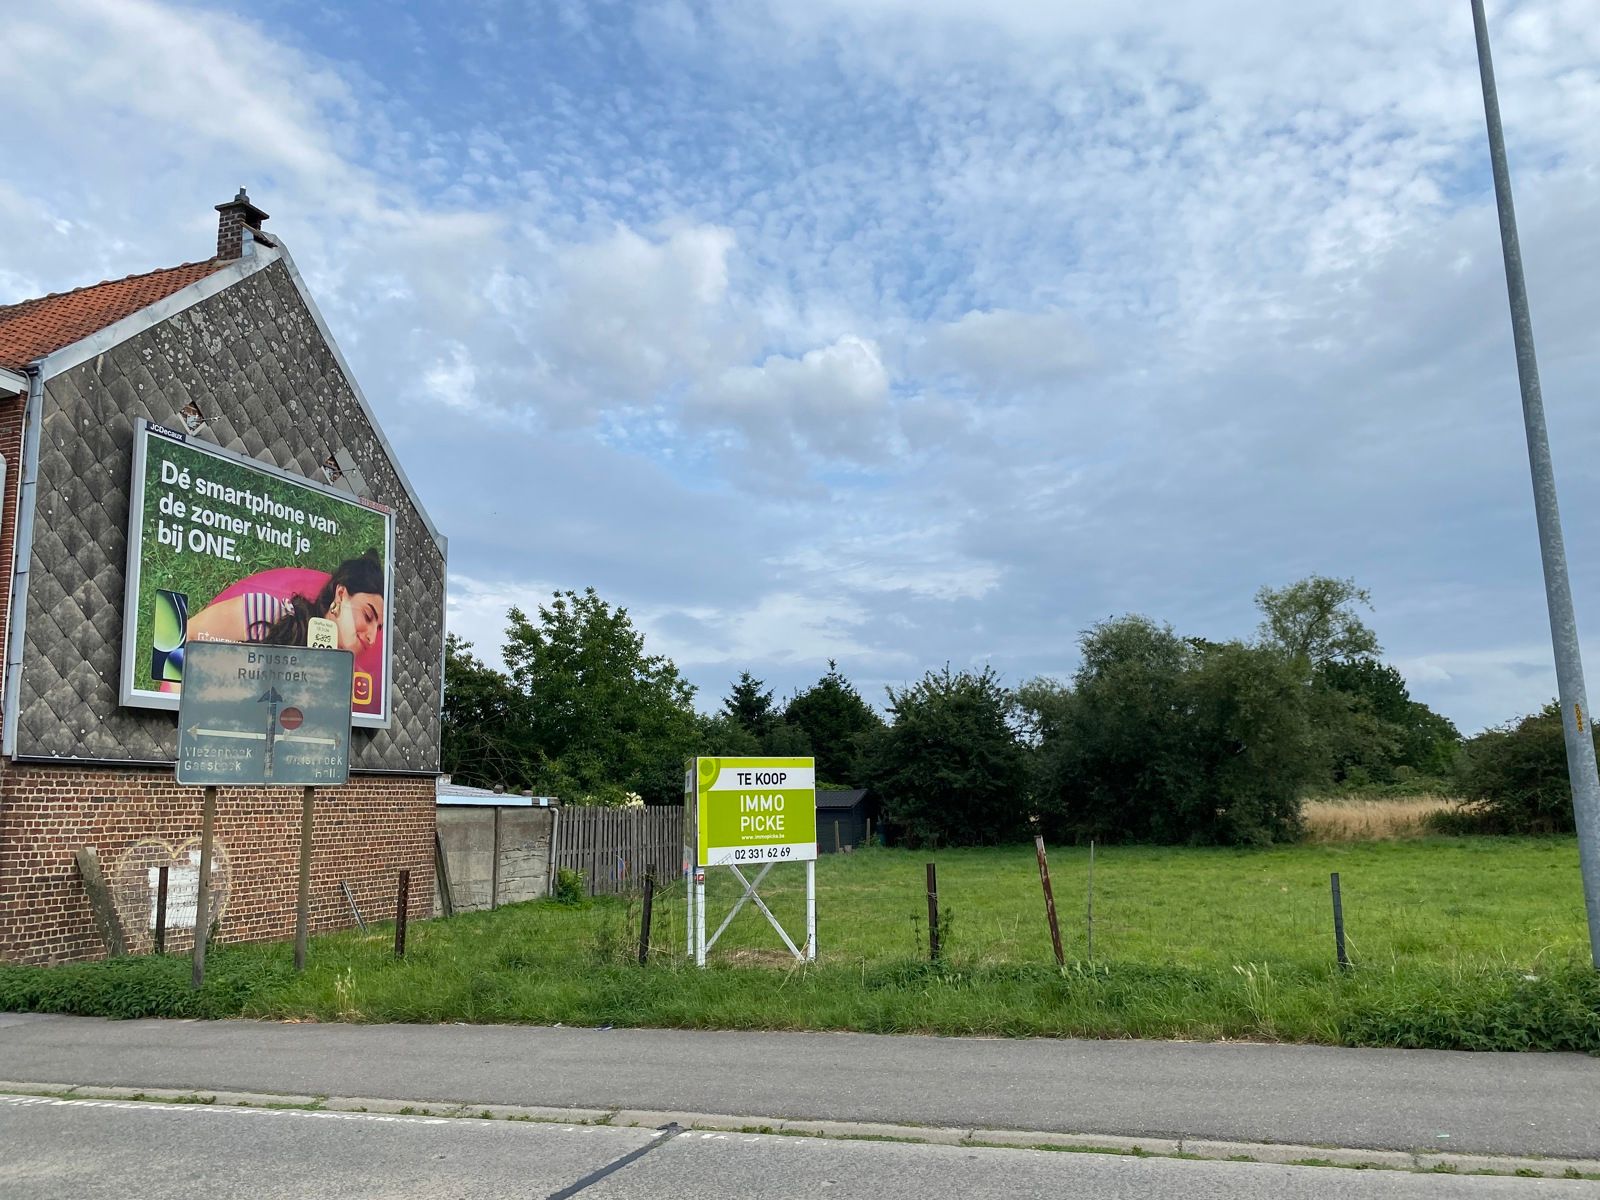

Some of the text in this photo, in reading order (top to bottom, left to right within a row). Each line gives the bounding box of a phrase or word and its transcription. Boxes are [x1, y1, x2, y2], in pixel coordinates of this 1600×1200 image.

[150, 423, 183, 440] JCDecaux
[161, 460, 337, 535] Dé smartphone van
[159, 493, 311, 556] de zomer vind je
[157, 520, 242, 563] bij ONE.
[315, 767, 341, 778] Hll
[737, 772, 787, 786] TE KOOP
[740, 794, 785, 813] IMMO
[740, 815, 785, 832] PICKE
[734, 846, 791, 860] 02 331 62 69
